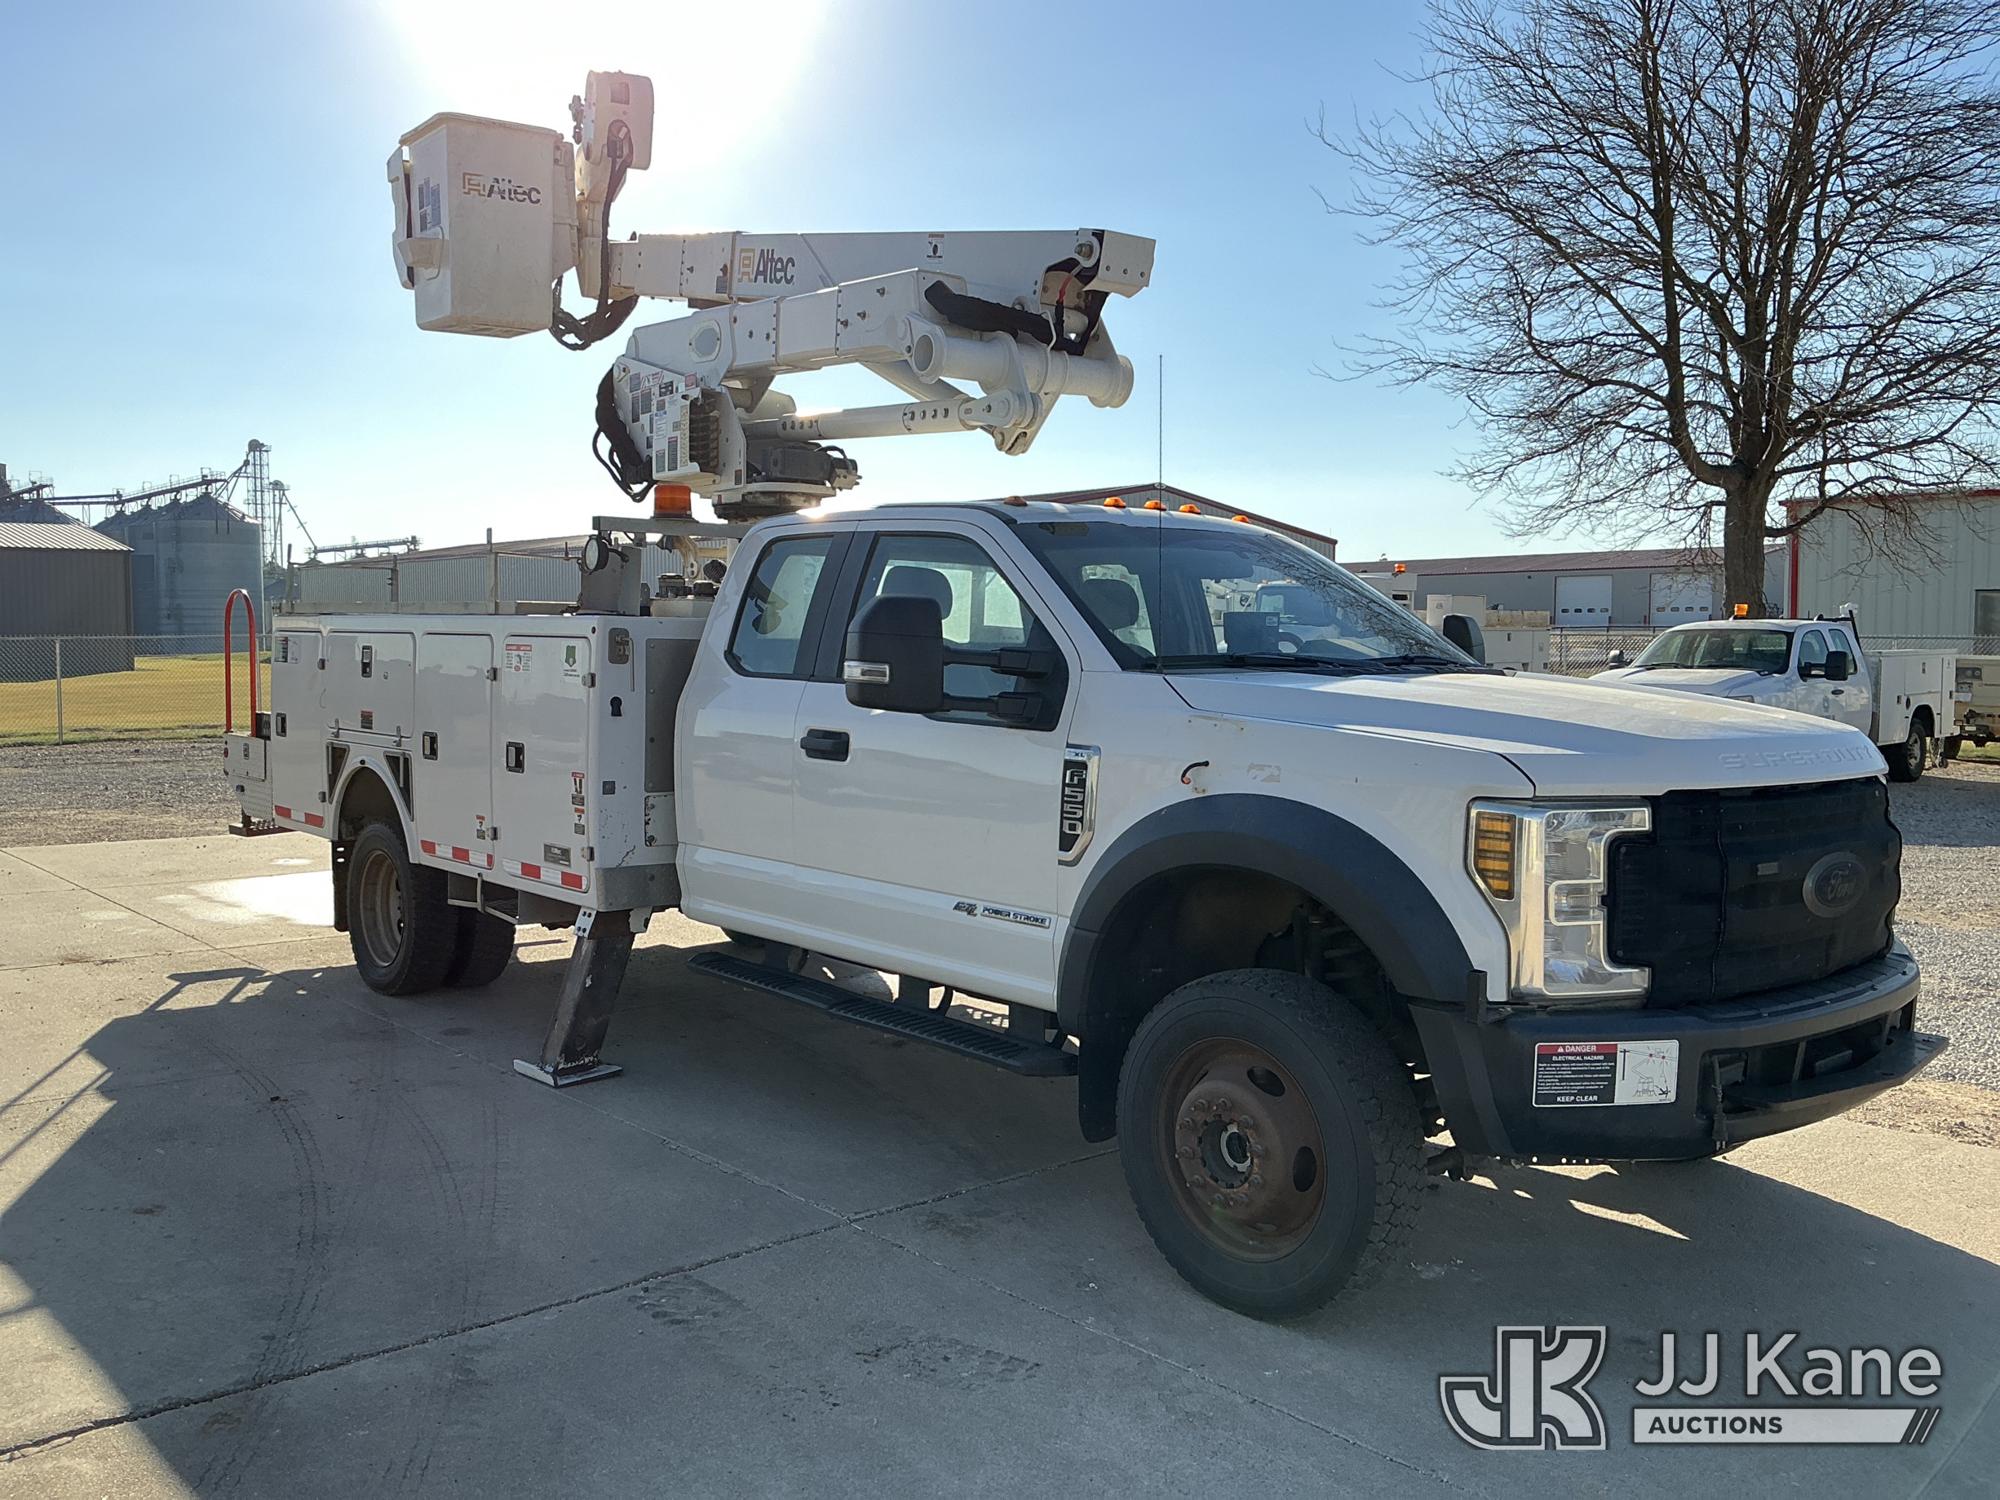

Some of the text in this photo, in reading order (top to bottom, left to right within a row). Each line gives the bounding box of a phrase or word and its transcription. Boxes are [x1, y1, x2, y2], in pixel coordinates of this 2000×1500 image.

[753, 248, 795, 285] Altec
[983, 906, 1011, 918] POWER
[1012, 913, 1047, 925] STROKE
[1565, 1045, 1597, 1053] DANGER
